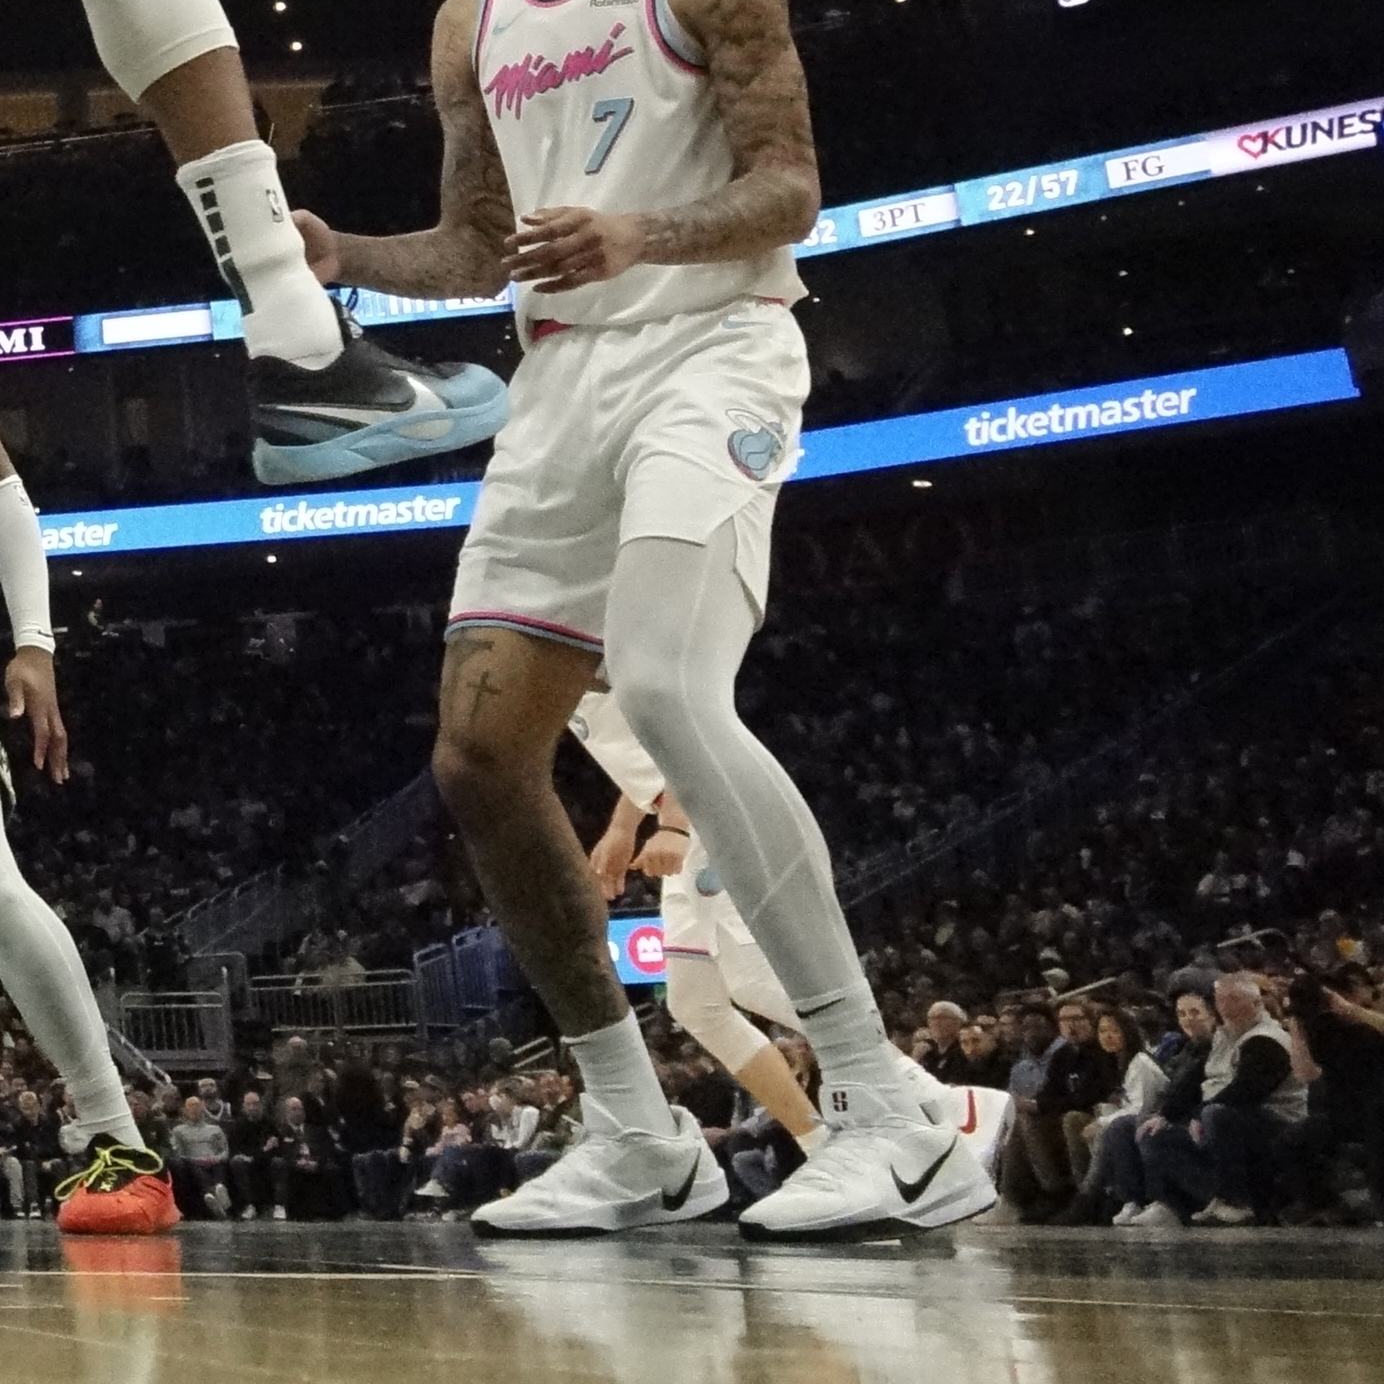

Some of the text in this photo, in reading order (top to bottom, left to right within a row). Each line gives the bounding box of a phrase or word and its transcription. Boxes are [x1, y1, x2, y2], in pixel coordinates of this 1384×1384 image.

[484, 22, 634, 120] Miami
[585, 98, 634, 176] 7
[1260, 107, 1383, 155] KUNES
[874, 203, 925, 232] 3PT
[987, 169, 1078, 212] 22/57
[1122, 155, 1165, 181] FG
[965, 386, 1197, 447] ticketmaster
[260, 495, 461, 534] ticketmaster
